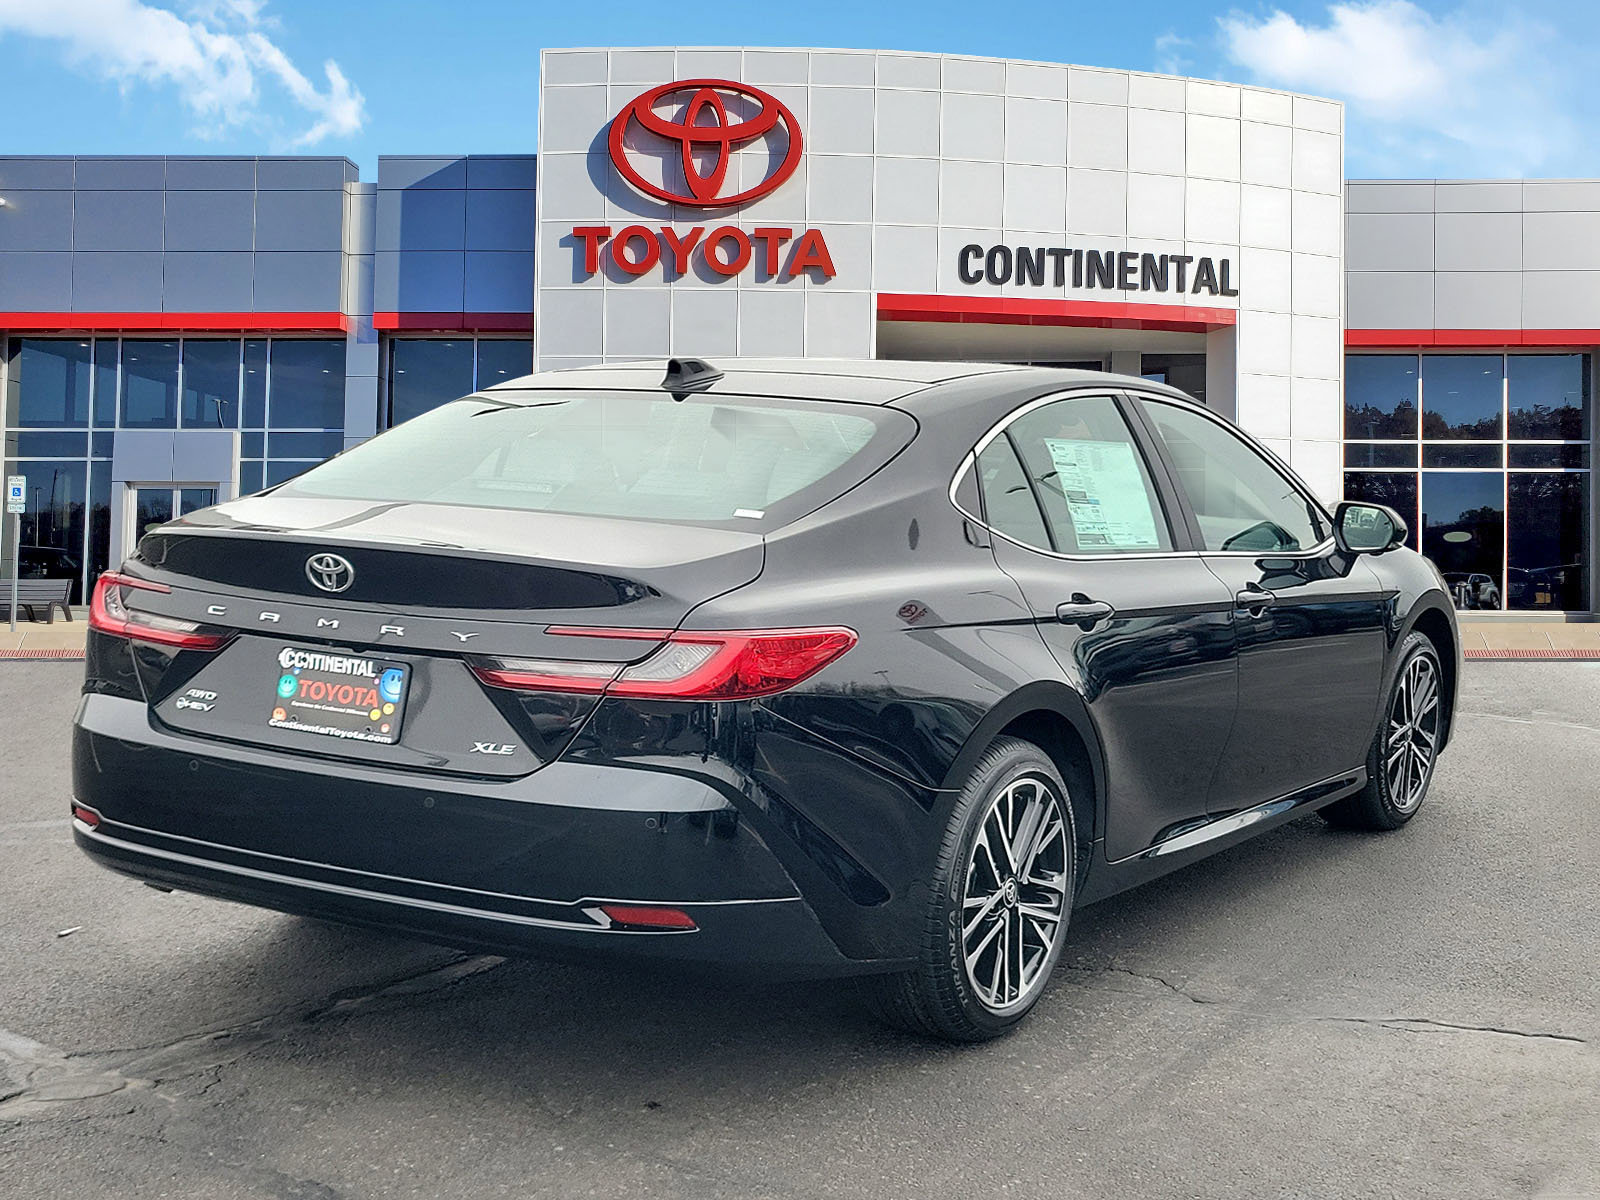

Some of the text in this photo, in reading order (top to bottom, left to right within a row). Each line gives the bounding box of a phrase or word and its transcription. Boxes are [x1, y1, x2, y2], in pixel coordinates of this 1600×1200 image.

[572, 225, 837, 278] TOYOTA
[957, 244, 1239, 297] CONTINENTAL
[207, 605, 480, 643] CAMRY
[278, 647, 377, 678] CONTINENTAL
[185, 688, 218, 701] AWD
[299, 679, 379, 708] TOYOTA
[268, 718, 392, 744] ContinentalToyota.com
[469, 741, 517, 755] XLE
[948, 910, 969, 1008] TURANZA
